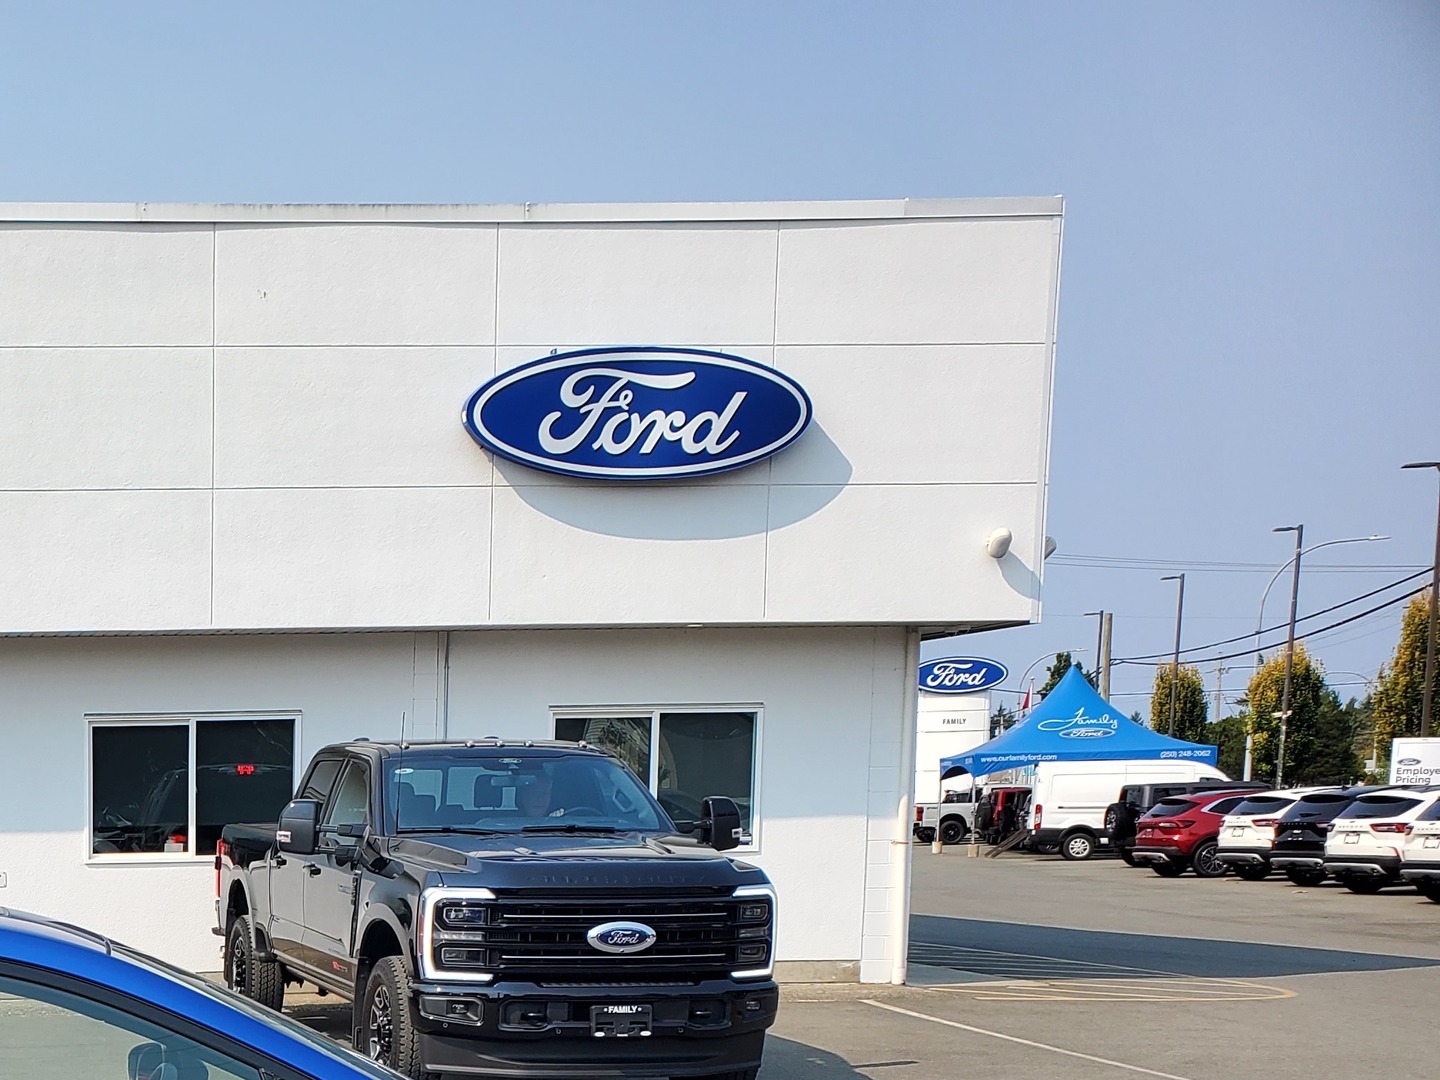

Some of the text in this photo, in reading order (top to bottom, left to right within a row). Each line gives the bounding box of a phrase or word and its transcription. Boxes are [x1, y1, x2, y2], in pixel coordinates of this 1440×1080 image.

[538, 368, 748, 455] Ford
[926, 662, 988, 687] Ford
[1037, 706, 1118, 729] Family
[1070, 729, 1104, 738] Ford
[980, 753, 1058, 763] www.ourfamilyford.com
[1160, 750, 1178, 759] (250)
[1395, 775, 1432, 786] Pricing
[607, 930, 640, 945] Ford
[607, 1005, 638, 1014] FAMILY
